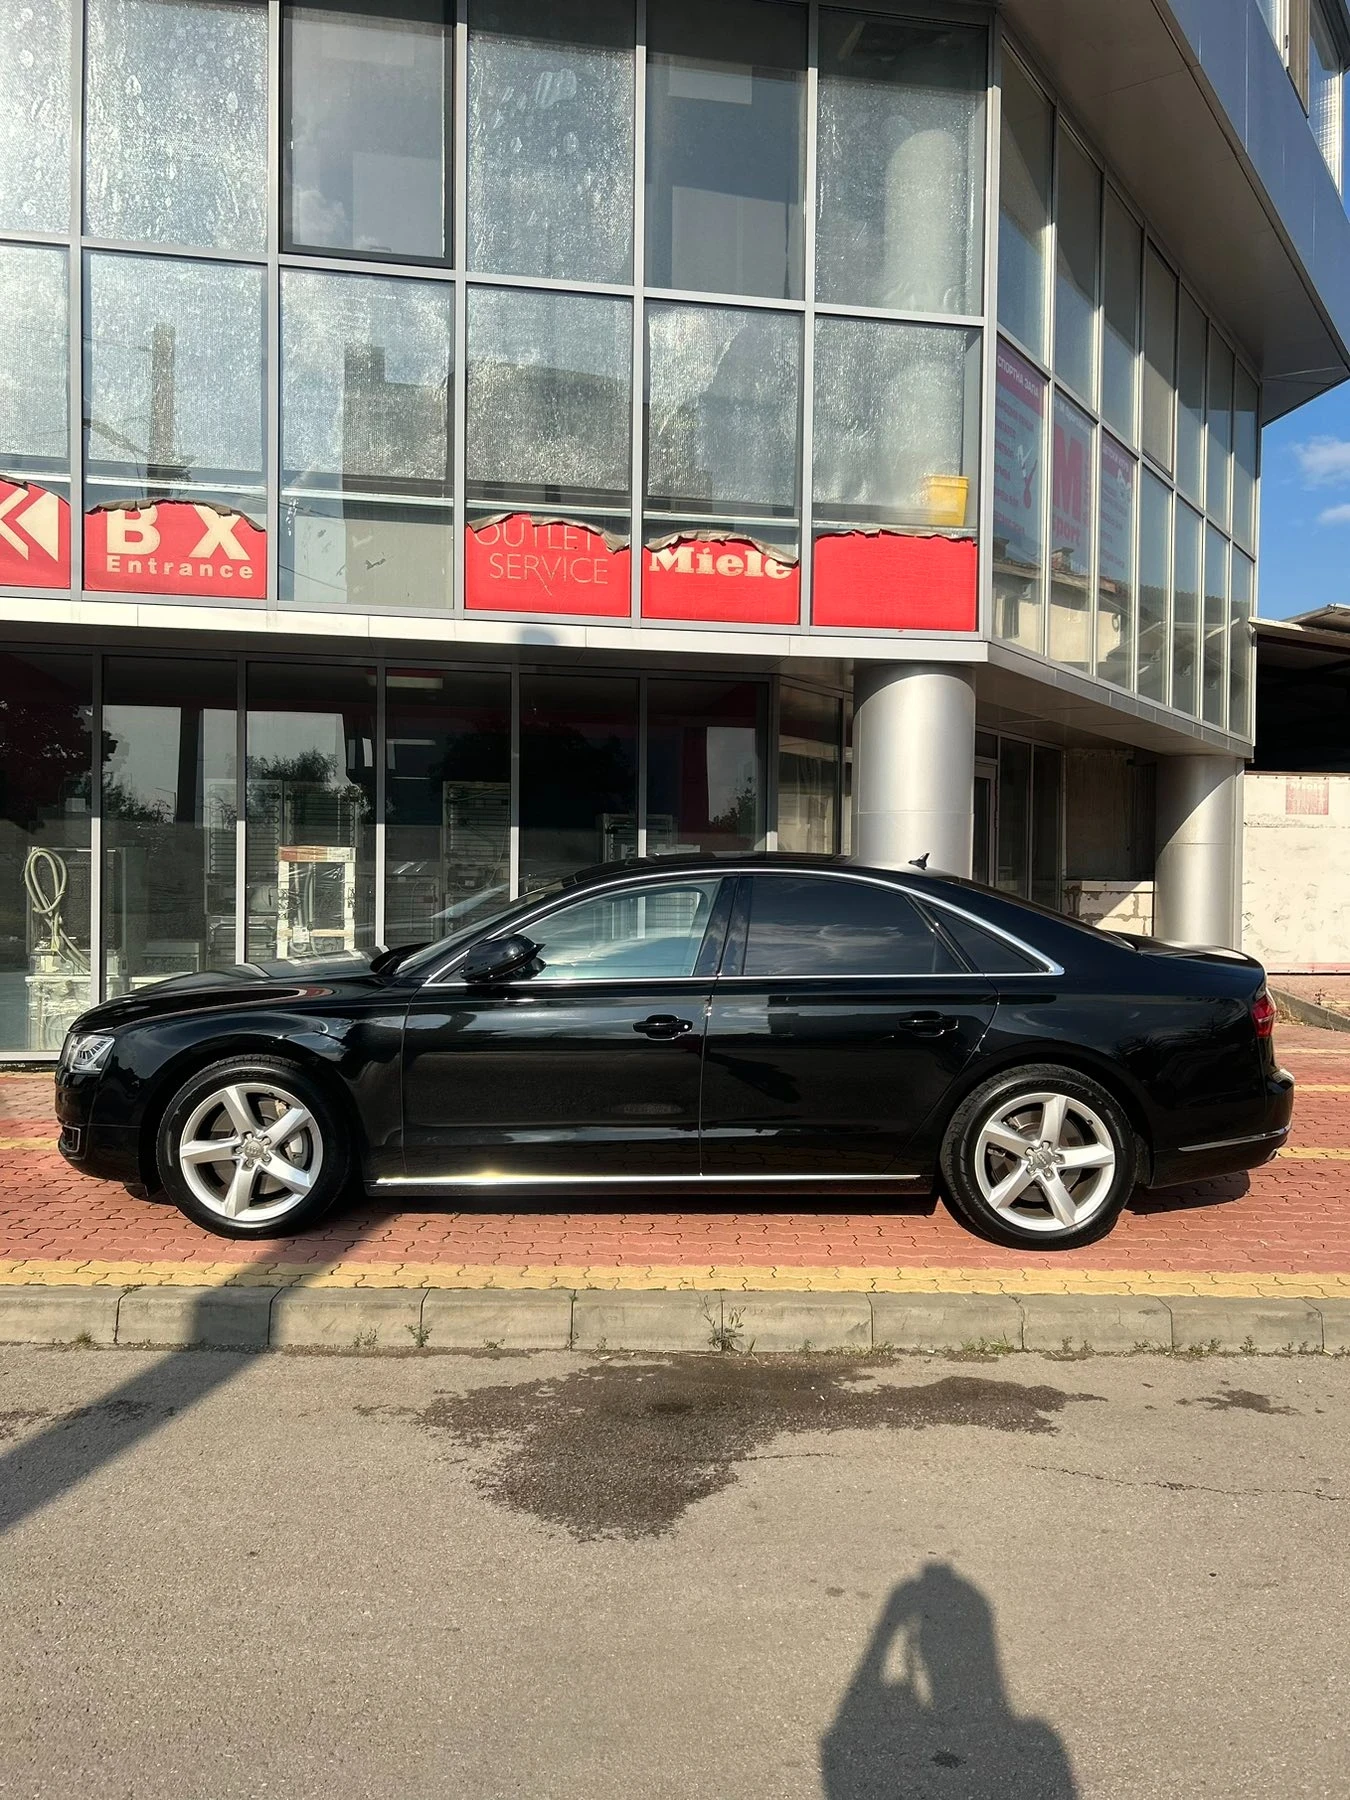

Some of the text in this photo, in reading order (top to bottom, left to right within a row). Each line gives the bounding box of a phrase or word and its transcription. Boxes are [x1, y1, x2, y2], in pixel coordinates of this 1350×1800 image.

[106, 555, 254, 579] Entrance
[489, 552, 608, 596] SERVICE
[649, 546, 792, 579] Miele
